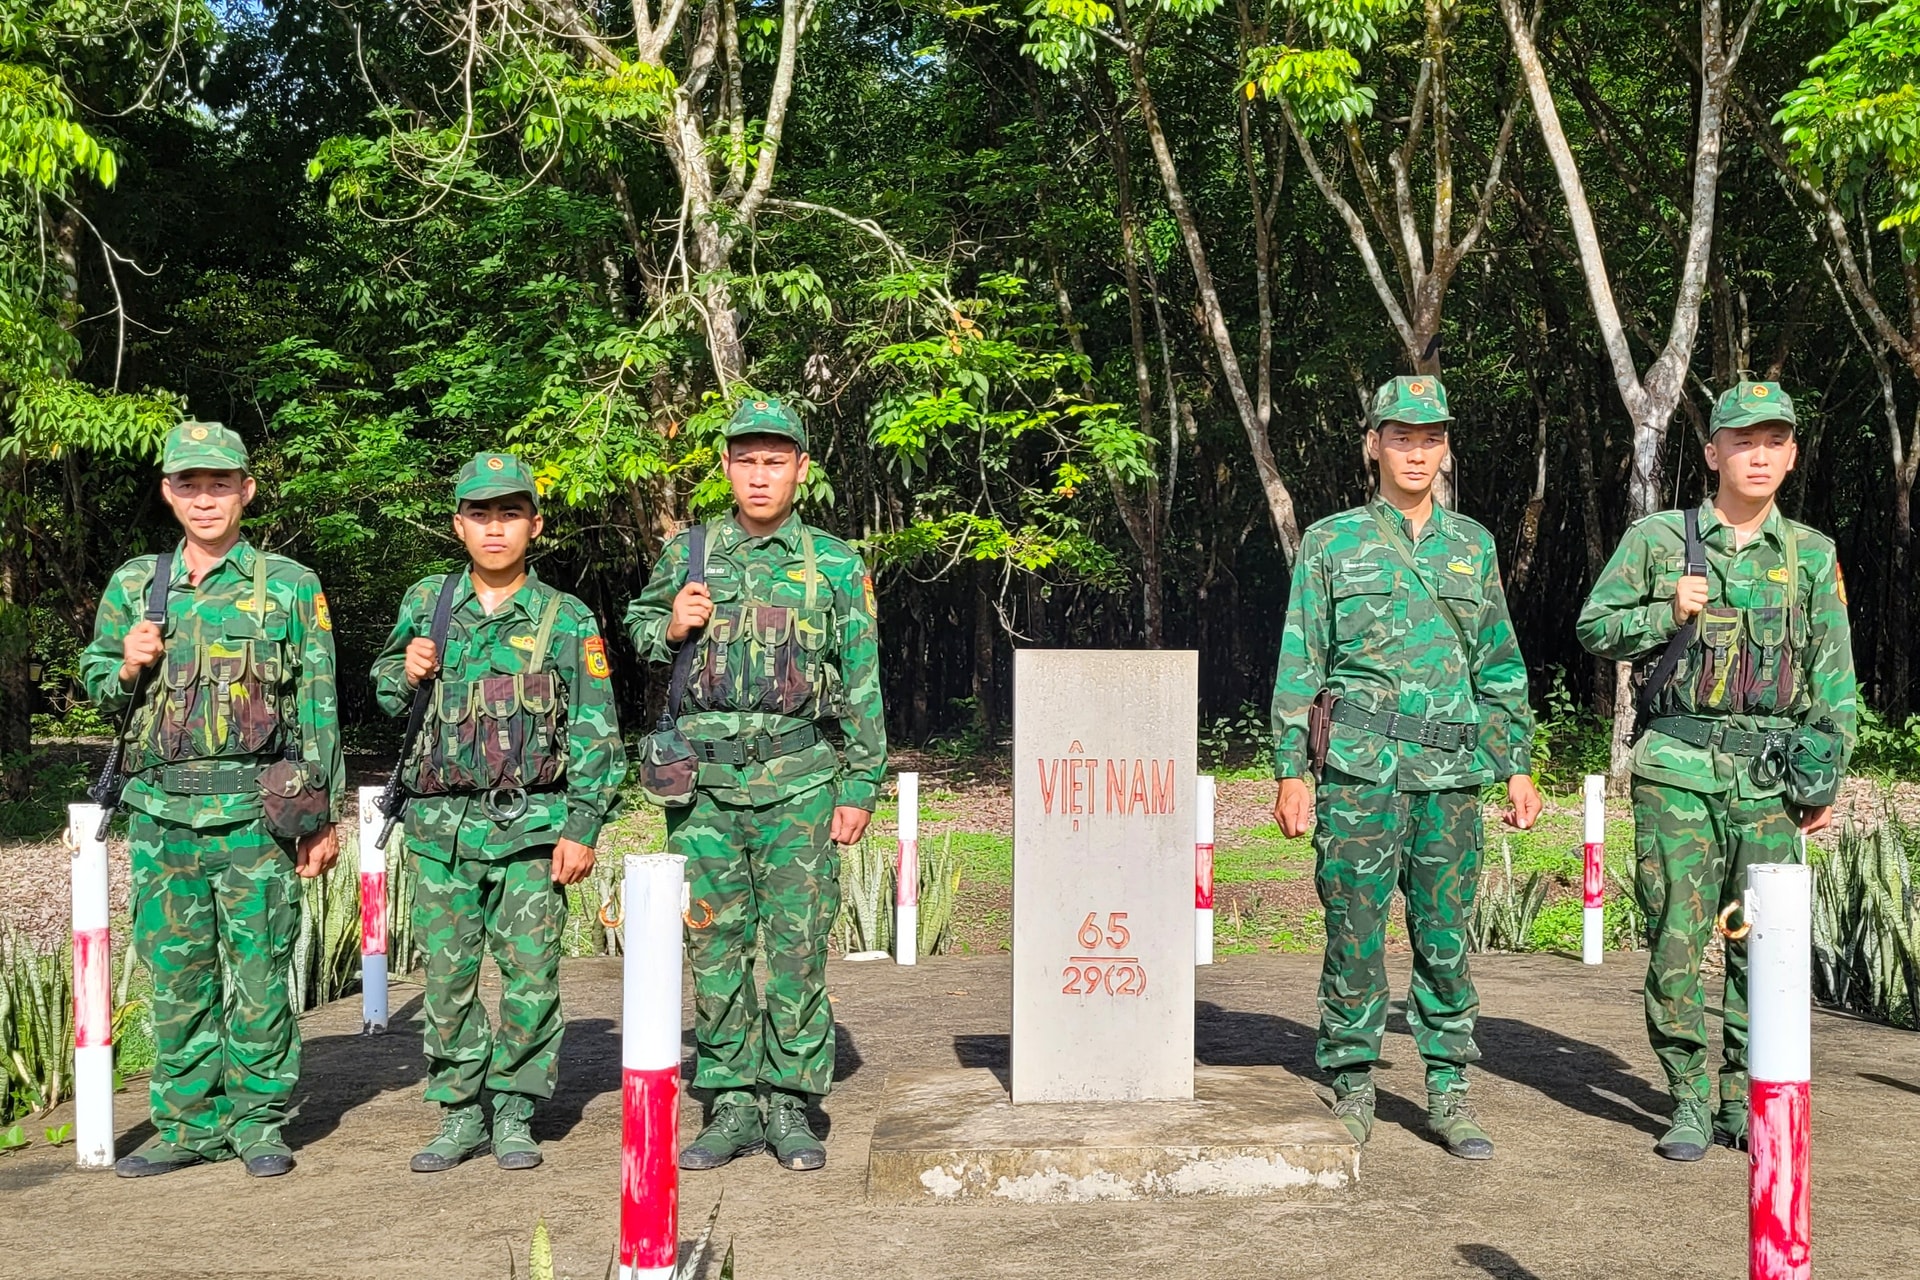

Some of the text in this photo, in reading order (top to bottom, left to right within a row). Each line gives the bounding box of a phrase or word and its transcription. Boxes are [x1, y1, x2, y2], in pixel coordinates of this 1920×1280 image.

[1038, 740, 1174, 832] VIỆT NAM
[1077, 911, 1130, 949] 65
[1062, 964, 1147, 996] 29(2)
